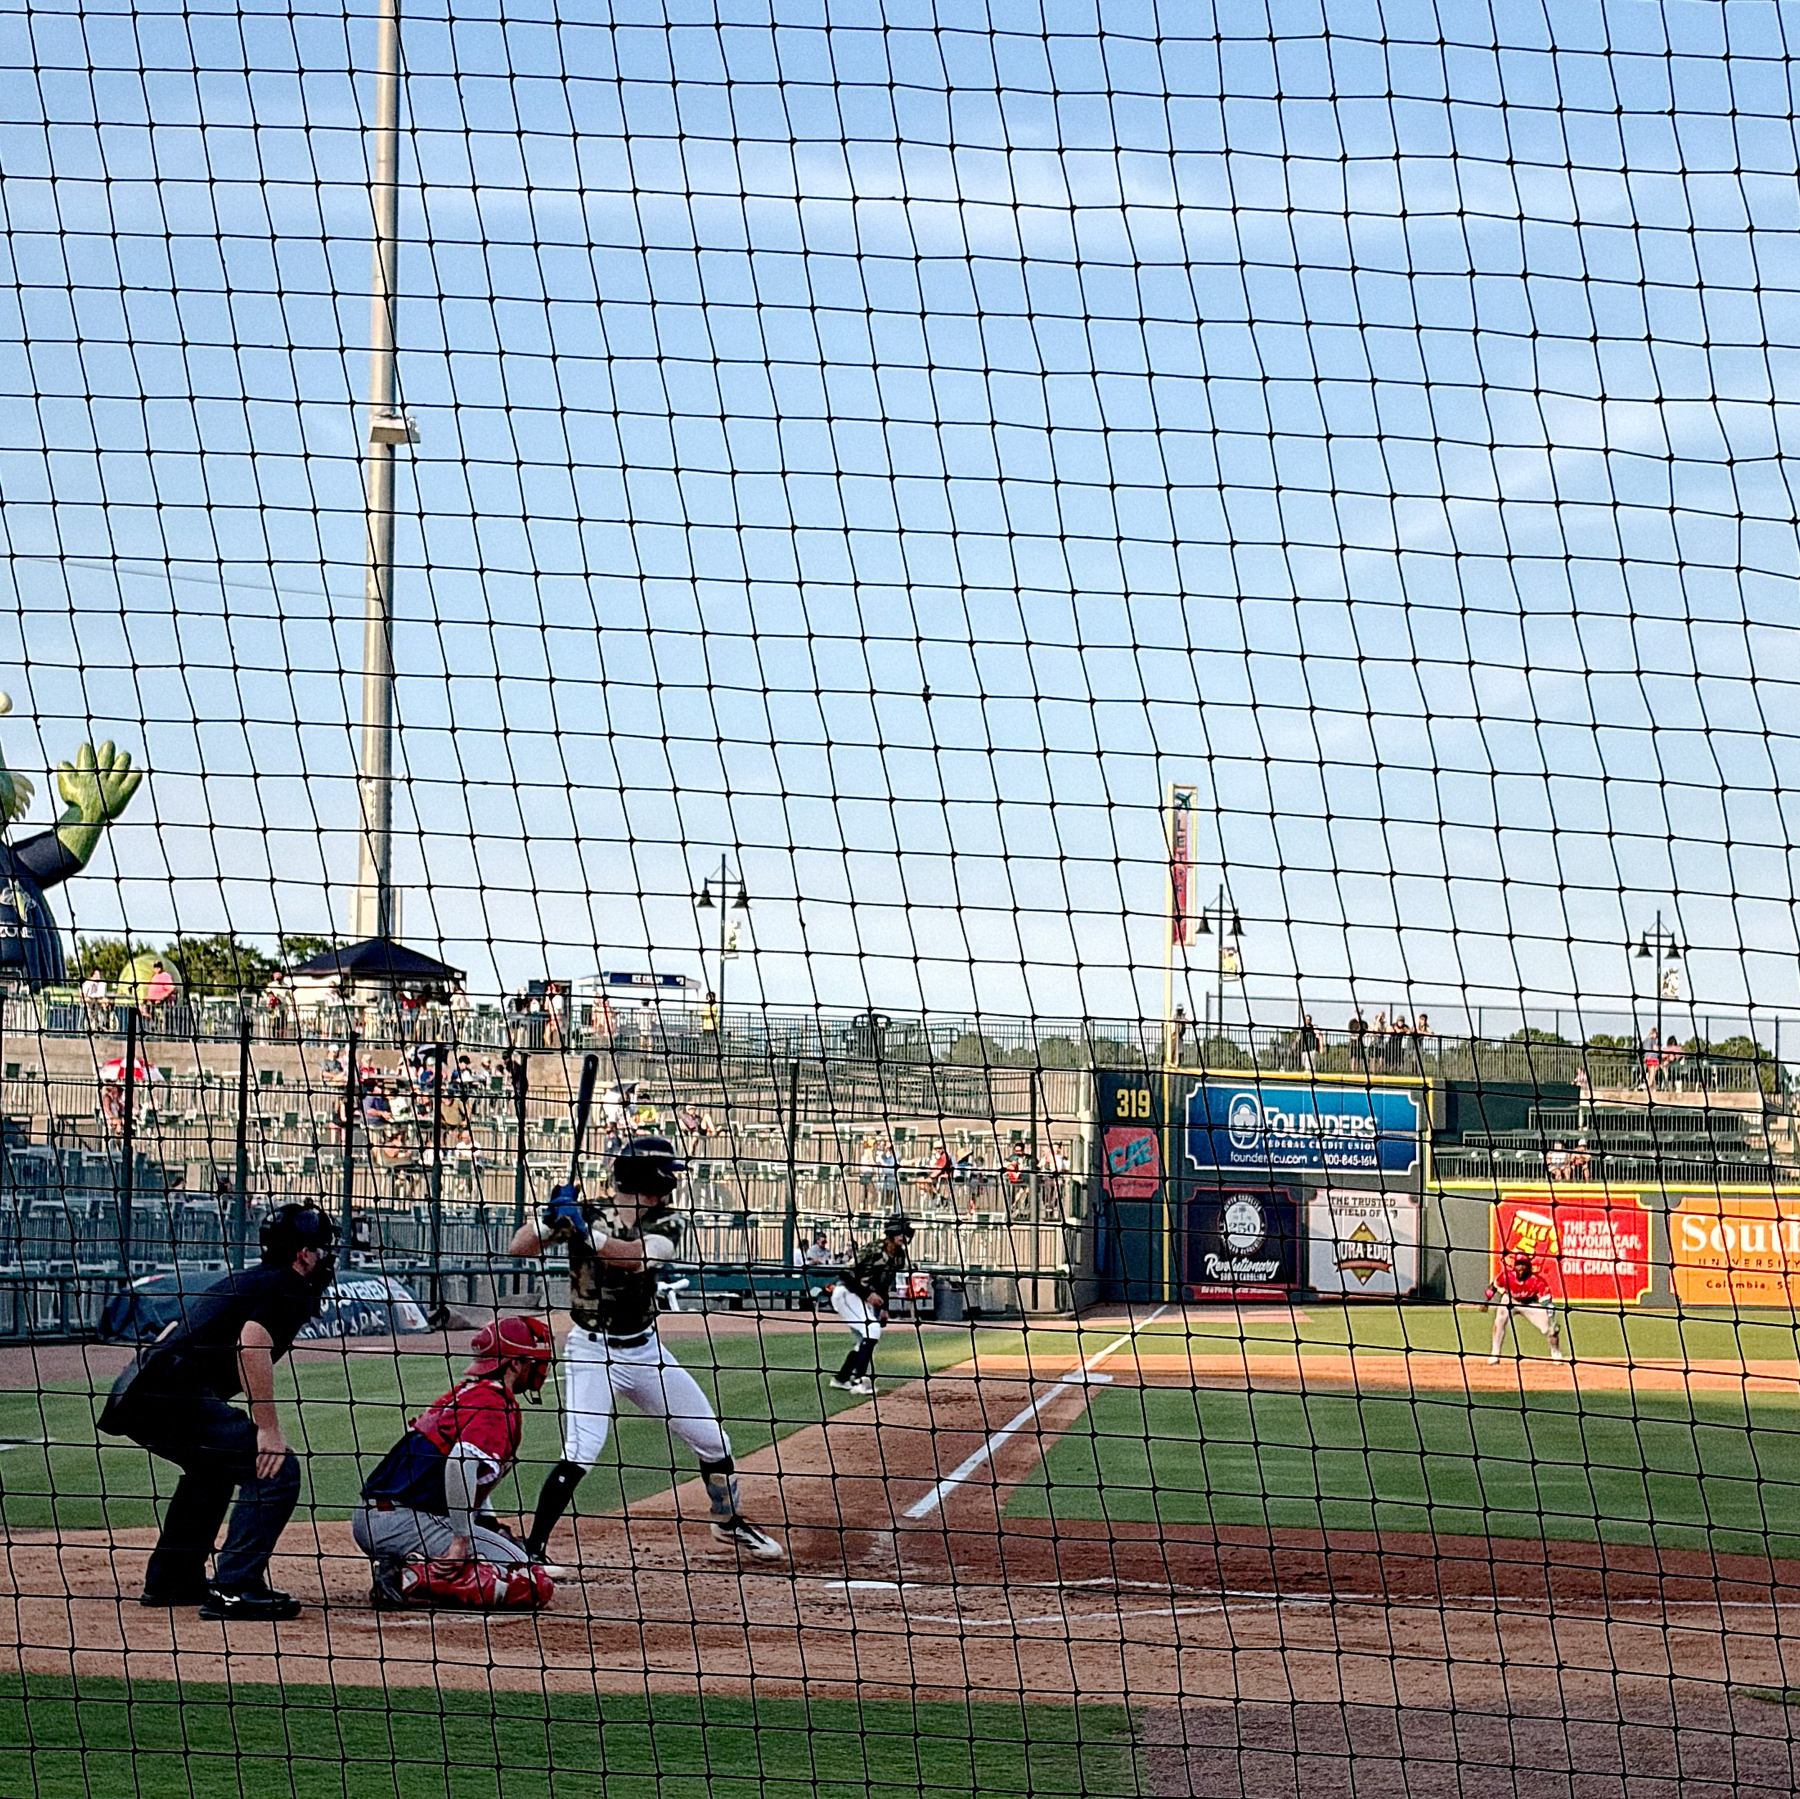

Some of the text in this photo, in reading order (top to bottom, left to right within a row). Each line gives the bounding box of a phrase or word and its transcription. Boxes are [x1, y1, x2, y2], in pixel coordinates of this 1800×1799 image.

[1116, 1089, 1151, 1118] 319
[1263, 1106, 1379, 1142] FOUNDERS
[1230, 1151, 1308, 1164] founderfcu.com
[1330, 1196, 1396, 1207] THE TRUSTED
[1369, 1209, 1381, 1218] OF
[1229, 1222, 1257, 1234] 250
[1512, 1216, 1549, 1241] TAKE
[1562, 1221, 1619, 1235] THE STAY
[1514, 1236, 1537, 1259] 5
[1562, 1235, 1577, 1248] IN
[1578, 1235, 1612, 1249] YOUR
[1576, 1248, 1627, 1262] MINUE
[1204, 1253, 1280, 1279] Revolutionary
[1562, 1260, 1582, 1274] OIL
[1220, 1273, 1238, 1281] SOUH
[1706, 1280, 1770, 1291] Colmbia,
